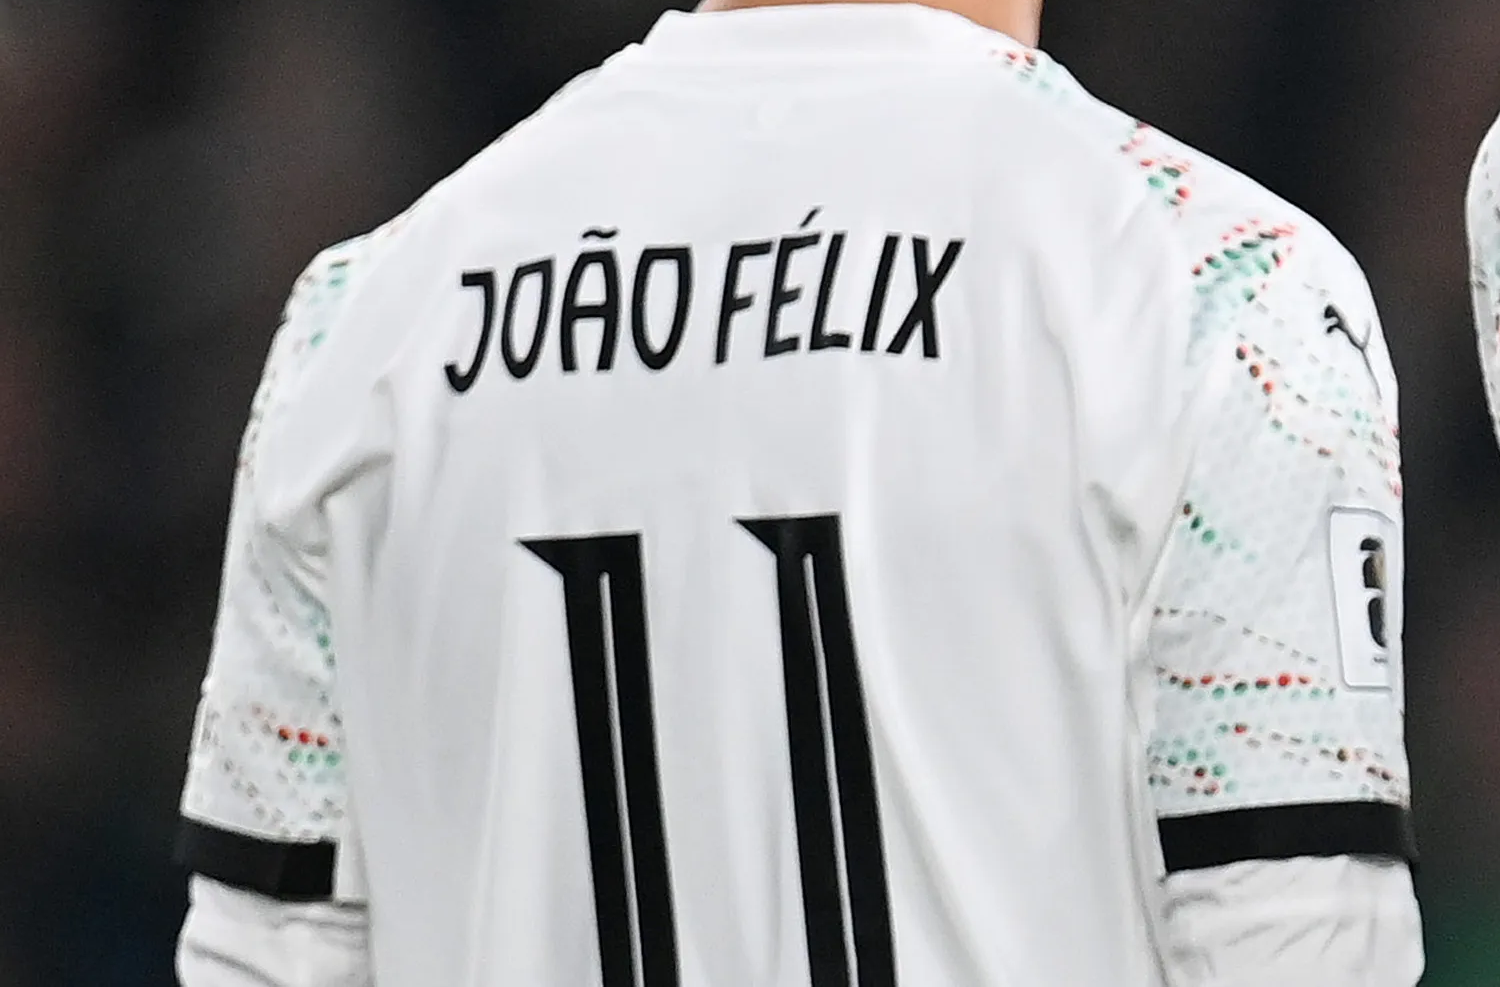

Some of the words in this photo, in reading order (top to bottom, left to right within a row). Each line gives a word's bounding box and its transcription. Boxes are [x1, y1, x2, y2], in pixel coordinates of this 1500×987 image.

[444, 227, 694, 394] JOÃO
[713, 206, 966, 365] FÉLIX
[514, 513, 900, 987] 11
